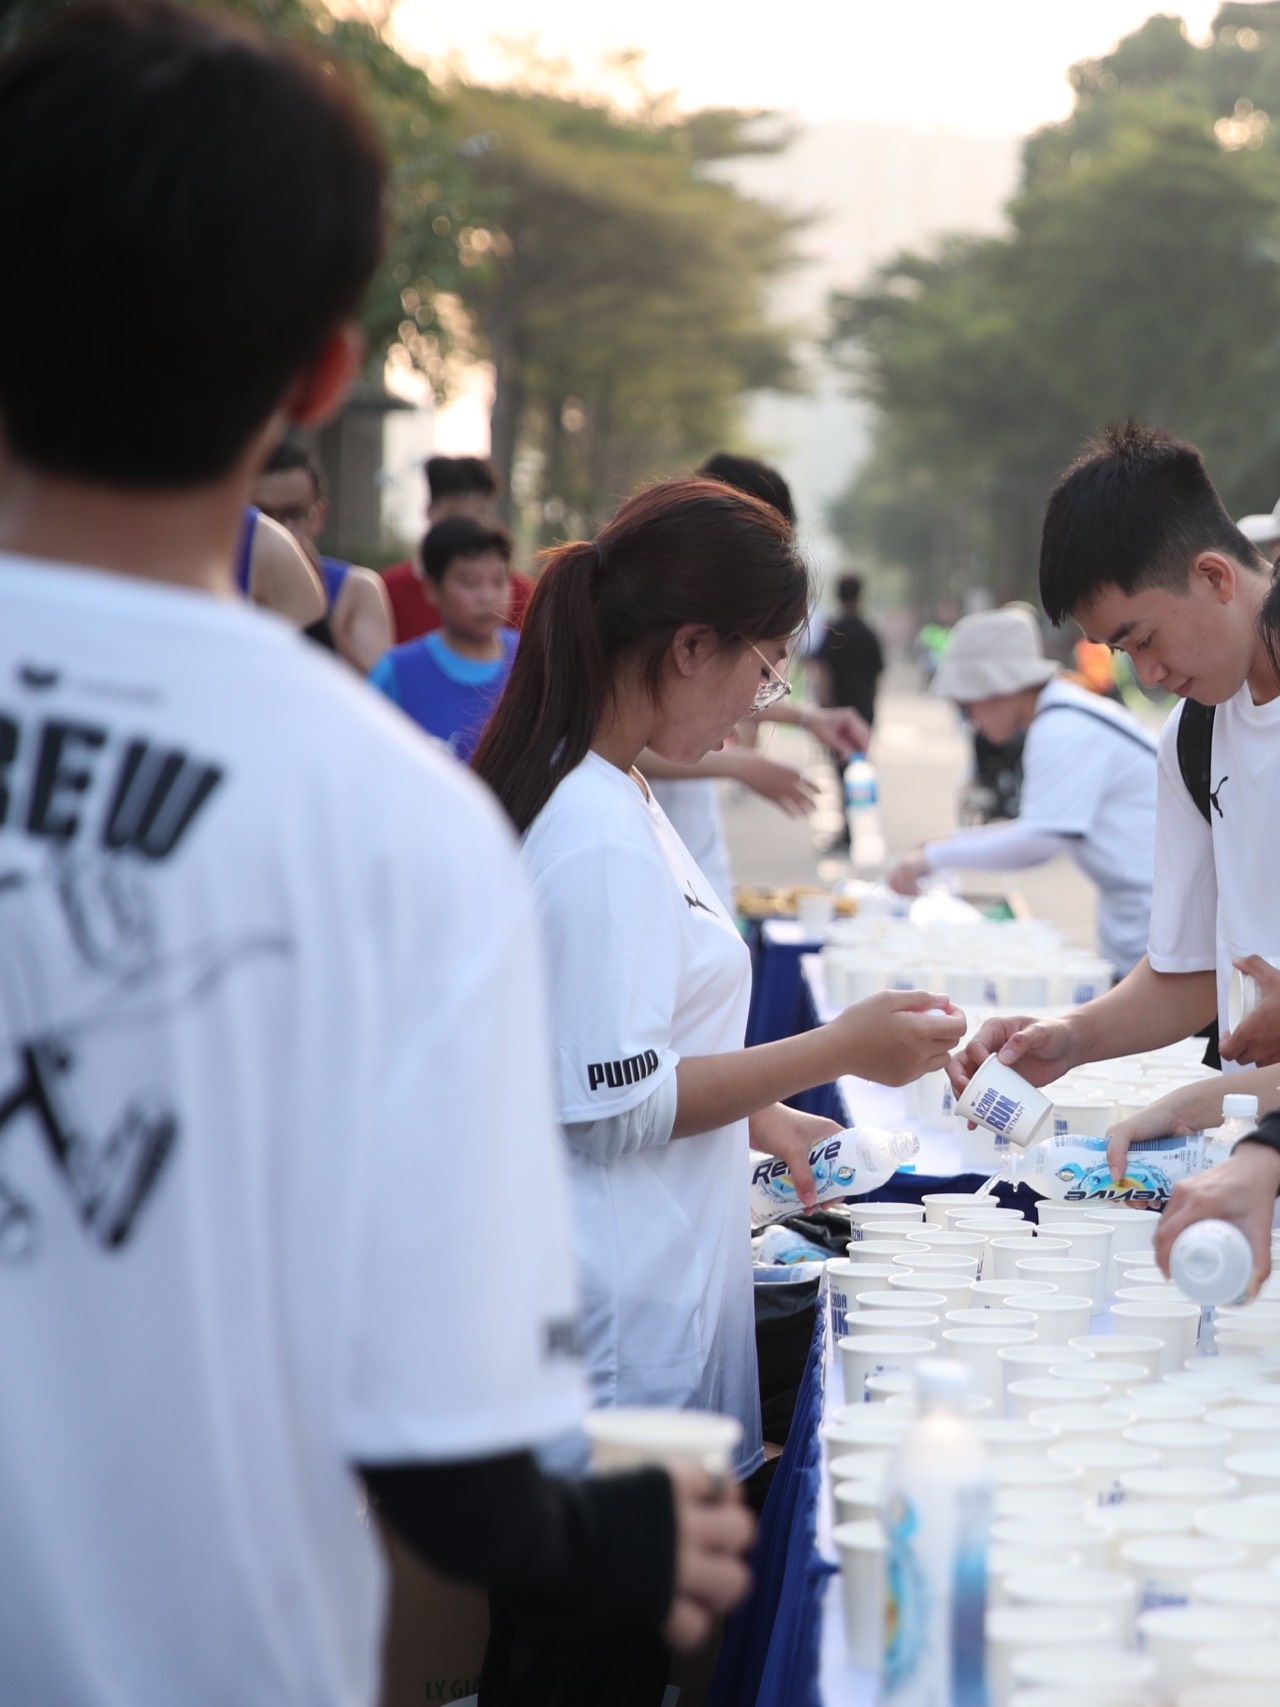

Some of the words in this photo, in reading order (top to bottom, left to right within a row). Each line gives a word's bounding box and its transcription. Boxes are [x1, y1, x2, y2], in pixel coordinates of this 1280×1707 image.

[587, 1050, 659, 1092] PUMA
[973, 1087, 999, 1120] LAZADA
[985, 1095, 1021, 1131] RUN
[1004, 1106, 1025, 1134] VIETNAM
[752, 1140, 842, 1185] Reve
